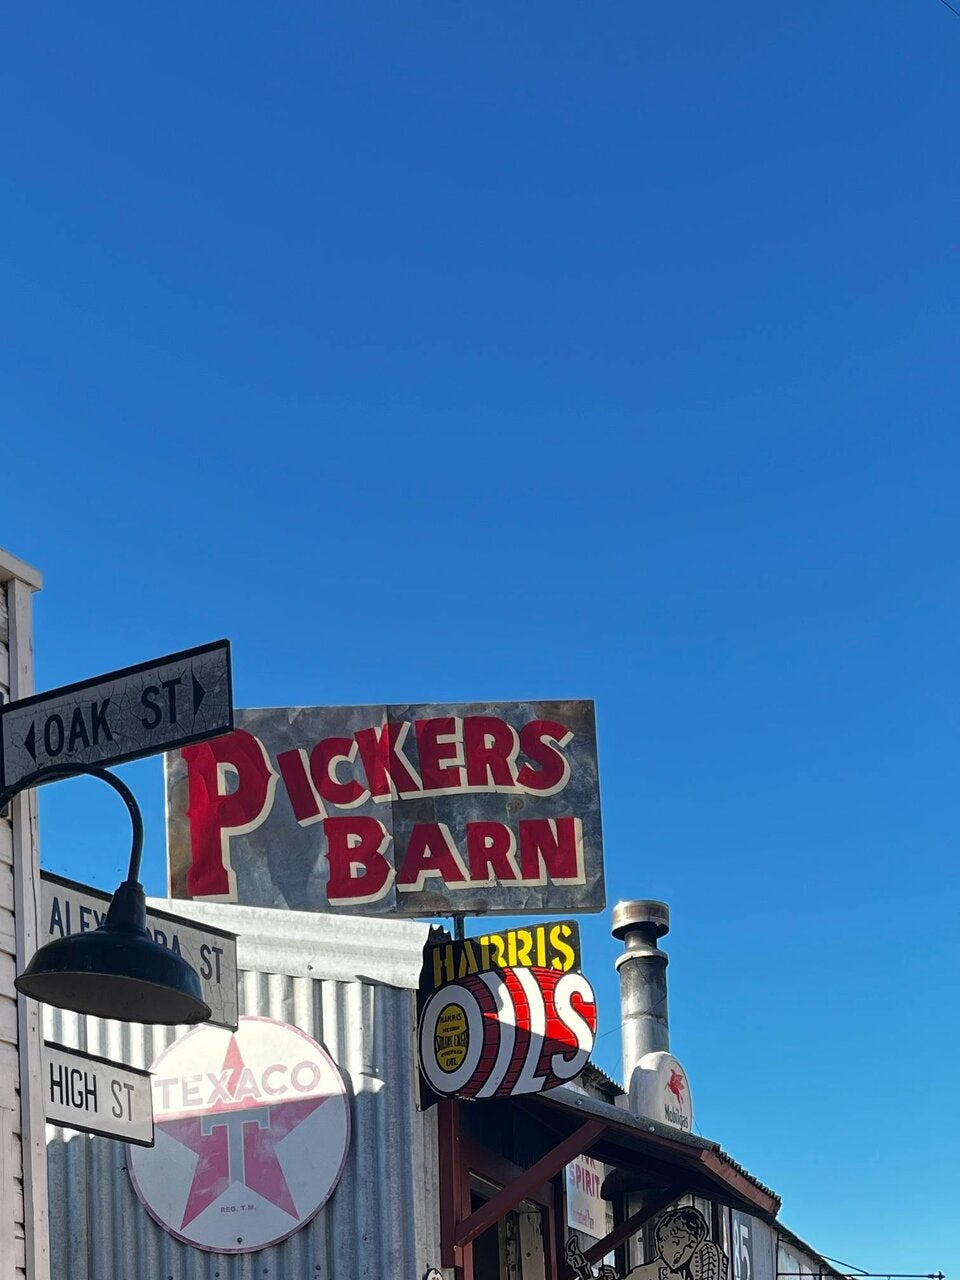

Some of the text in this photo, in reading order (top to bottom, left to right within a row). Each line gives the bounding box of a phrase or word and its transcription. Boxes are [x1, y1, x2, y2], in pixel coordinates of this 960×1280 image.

[43, 677, 182, 758] OAK ST
[181, 714, 574, 901] PICKERS
[323, 815, 585, 906] BARN
[199, 943, 224, 984] ST
[432, 924, 575, 987] HARRIS
[422, 967, 595, 1098] OILS
[49, 1062, 136, 1122] HIGH ST
[153, 1060, 322, 1110] TEXACO
[664, 1103, 689, 1132] Mobilgas
[569, 1162, 601, 1201] SPIRIT
